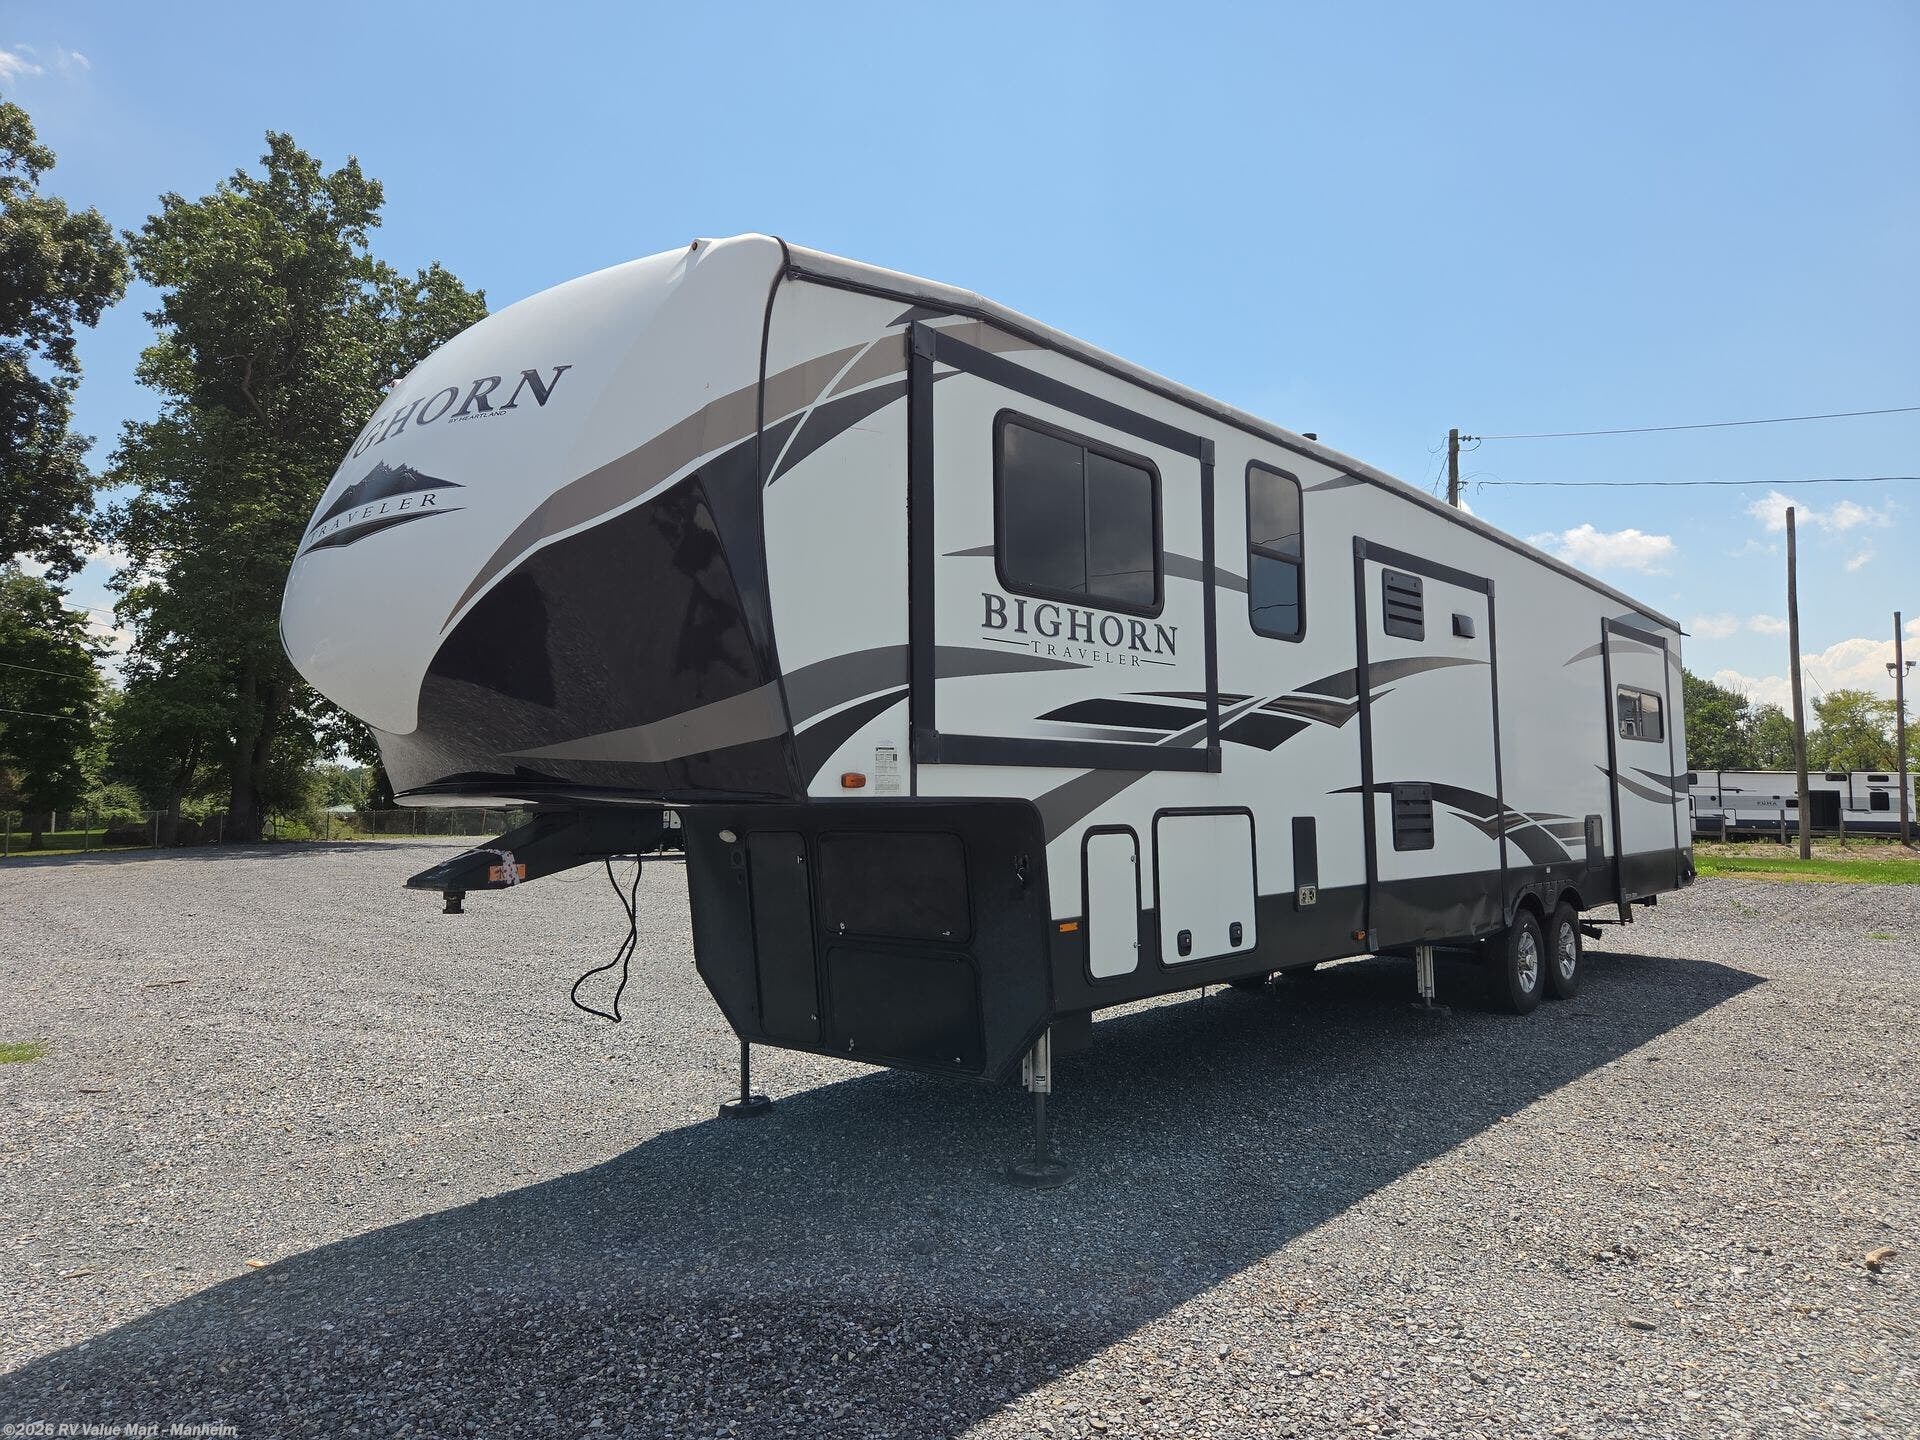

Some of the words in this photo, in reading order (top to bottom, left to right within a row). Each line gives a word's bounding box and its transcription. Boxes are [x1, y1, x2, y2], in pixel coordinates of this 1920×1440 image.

[458, 410, 507, 422] HEARTLAND
[308, 493, 437, 544] TRAVELER
[981, 592, 1178, 656] BIGHORN
[1031, 640, 1142, 667] TRAVELER
